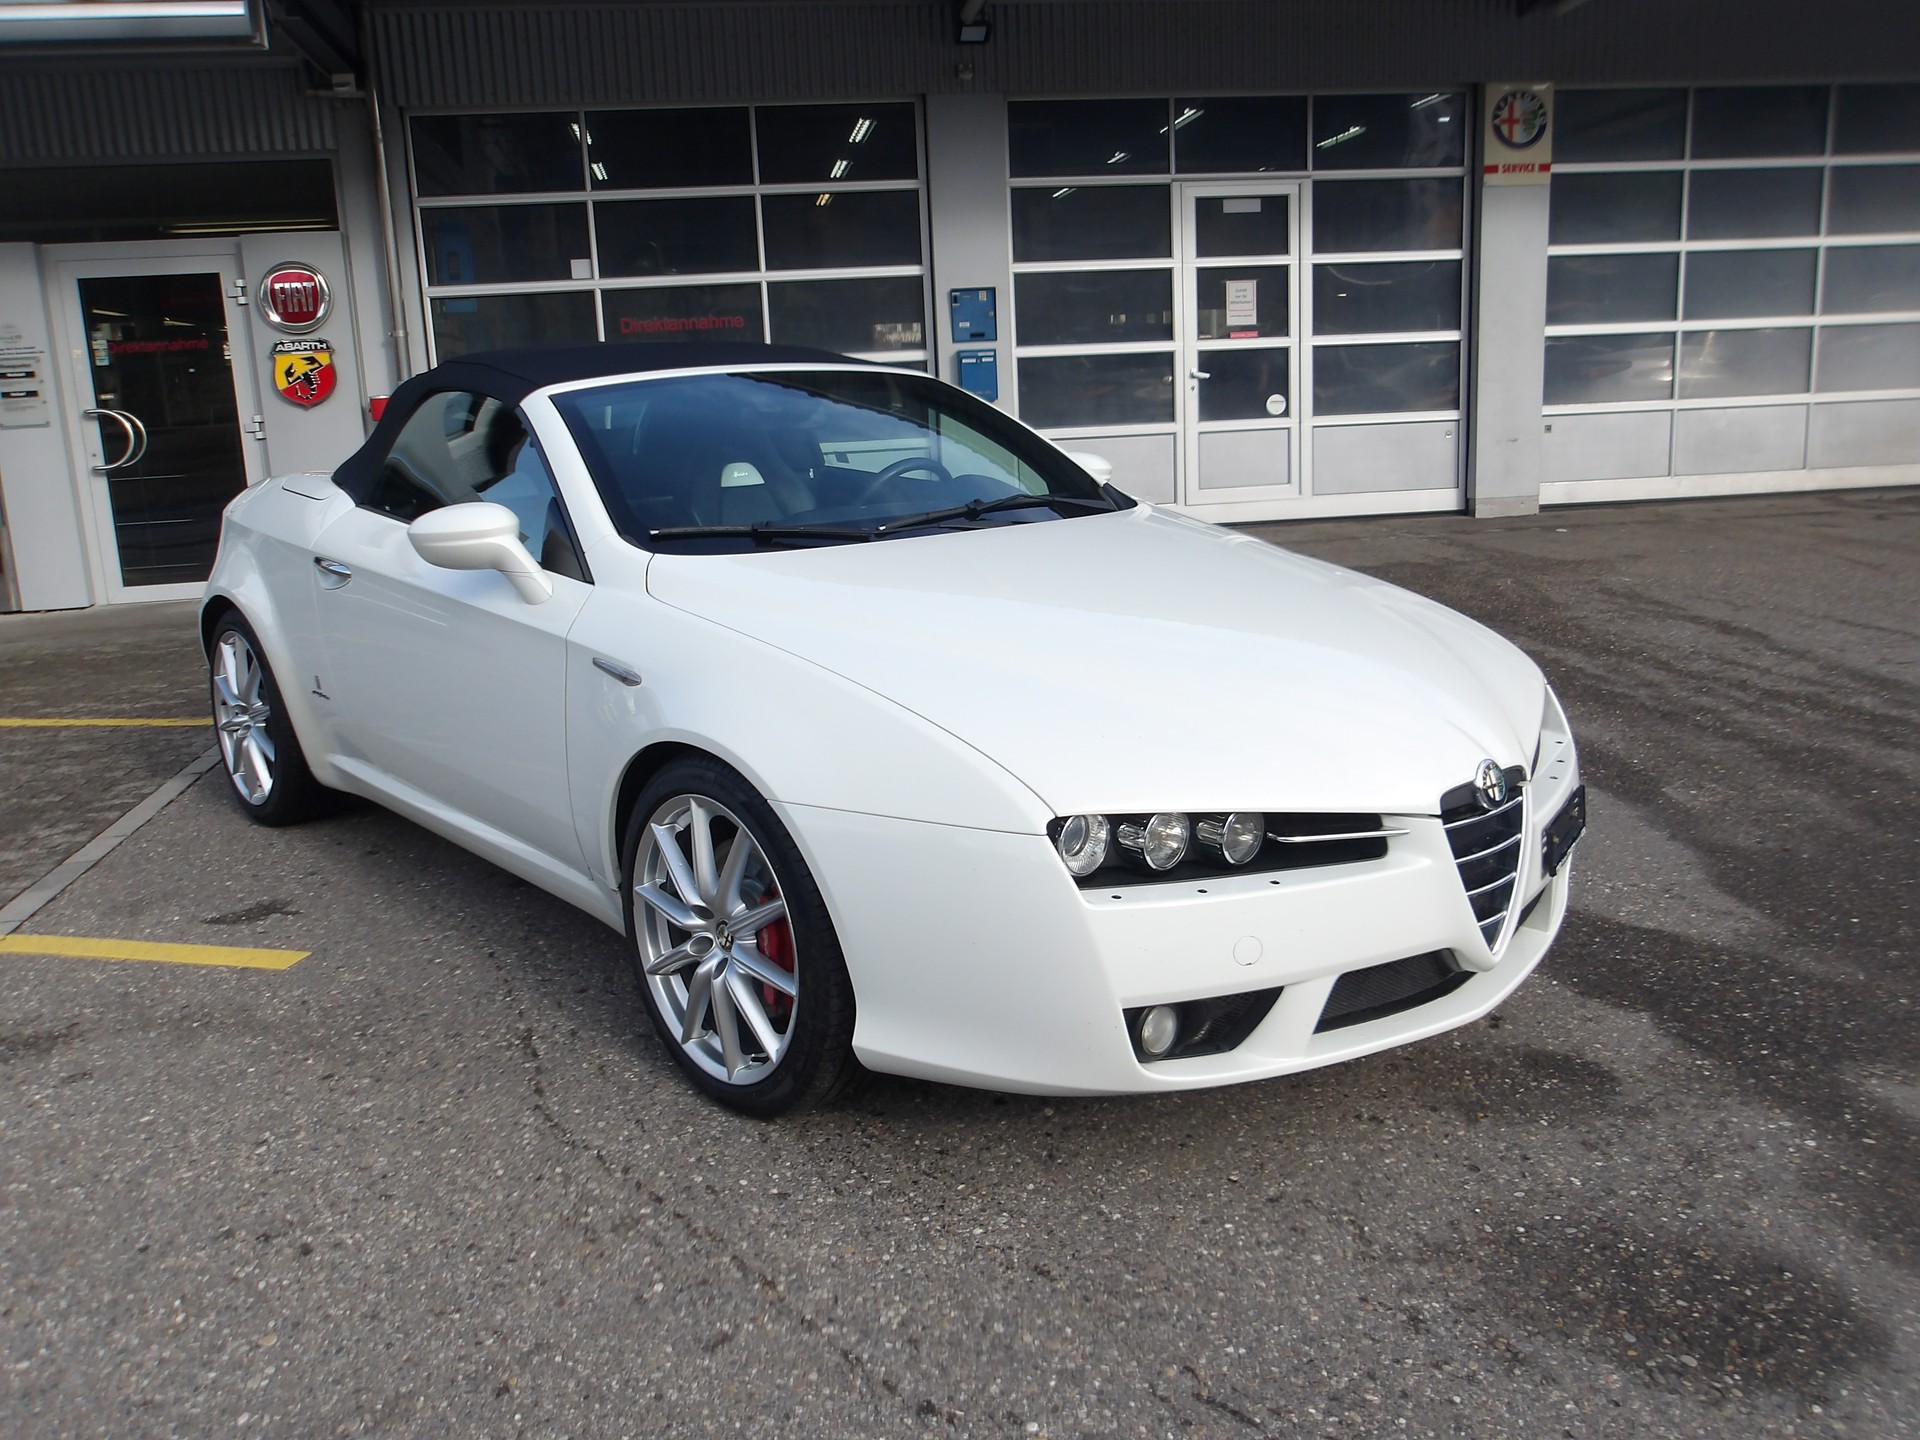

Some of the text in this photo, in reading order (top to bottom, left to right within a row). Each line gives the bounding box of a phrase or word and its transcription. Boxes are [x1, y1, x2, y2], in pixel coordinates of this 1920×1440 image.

[1502, 163, 1536, 173] SERVICE
[274, 281, 315, 313] FIAT
[620, 314, 745, 334] Direktannahme
[275, 341, 327, 352] ABARTH
